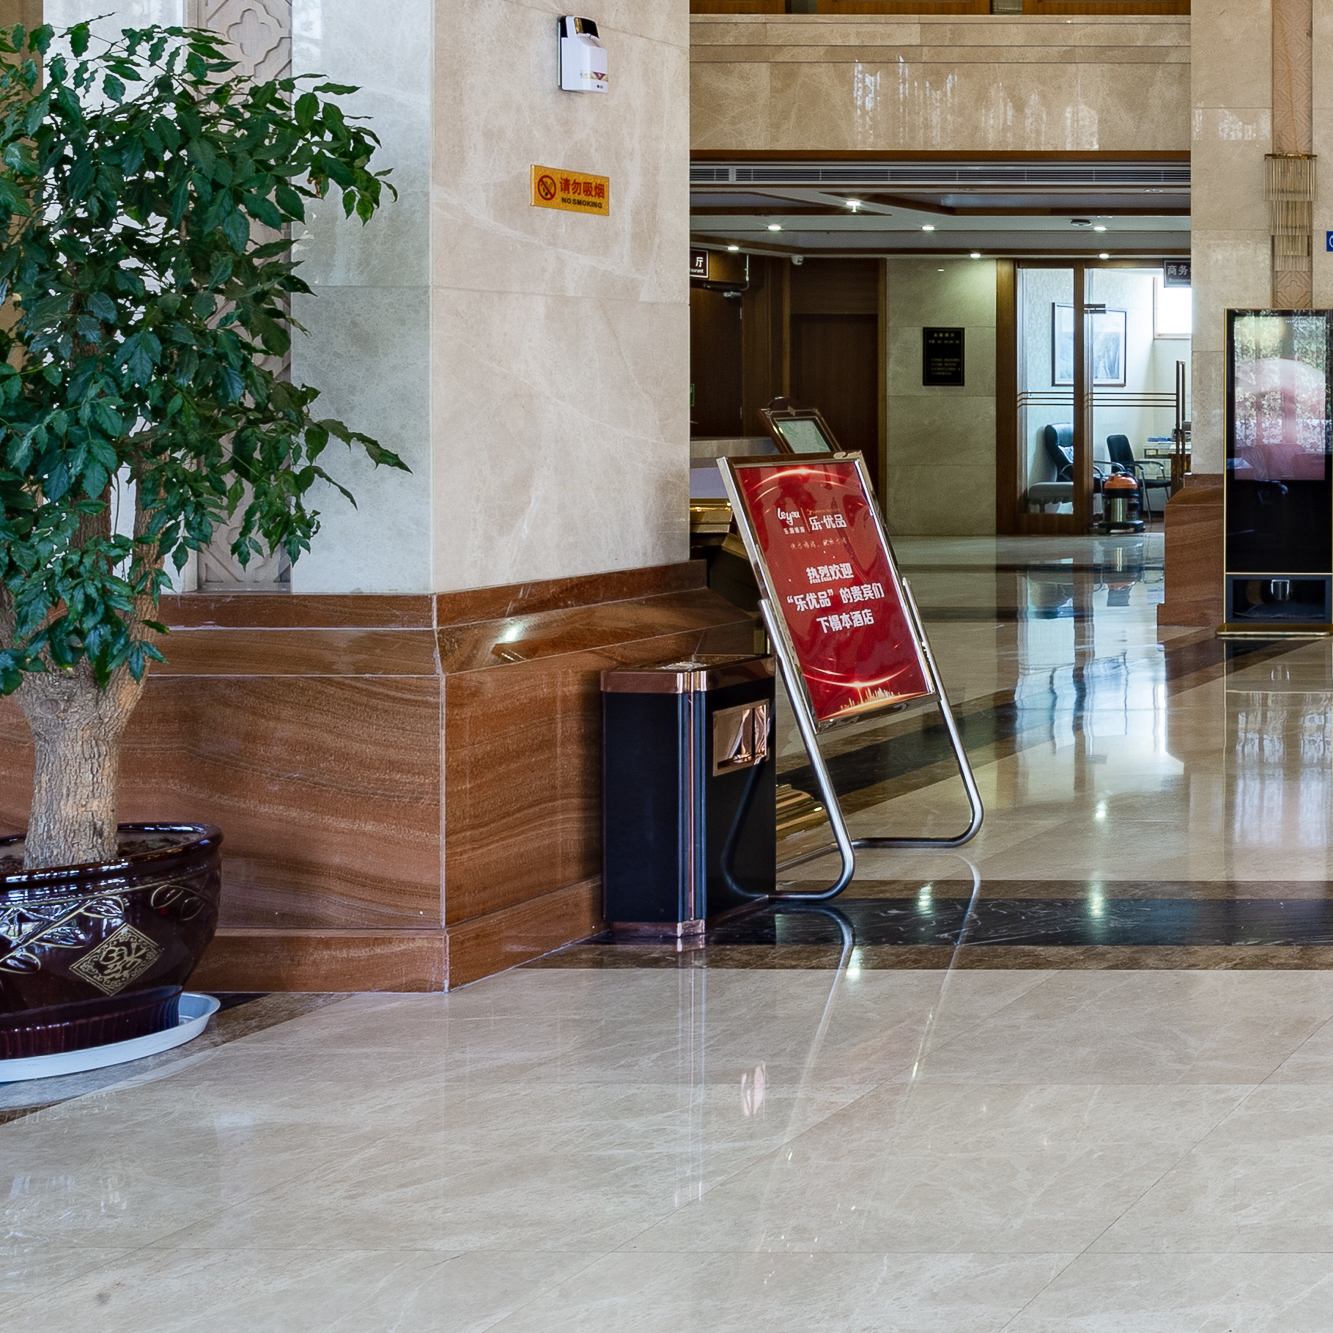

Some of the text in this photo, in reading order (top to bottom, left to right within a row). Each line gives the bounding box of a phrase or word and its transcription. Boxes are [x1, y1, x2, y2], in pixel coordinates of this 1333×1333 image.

[560, 177, 605, 199] 请勿吸烟
[572, 199, 603, 209] SMOKING
[1167, 264, 1191, 276] 商务
[806, 562, 855, 584] 热烈欢迎
[816, 608, 875, 634] 下榻本酒店
